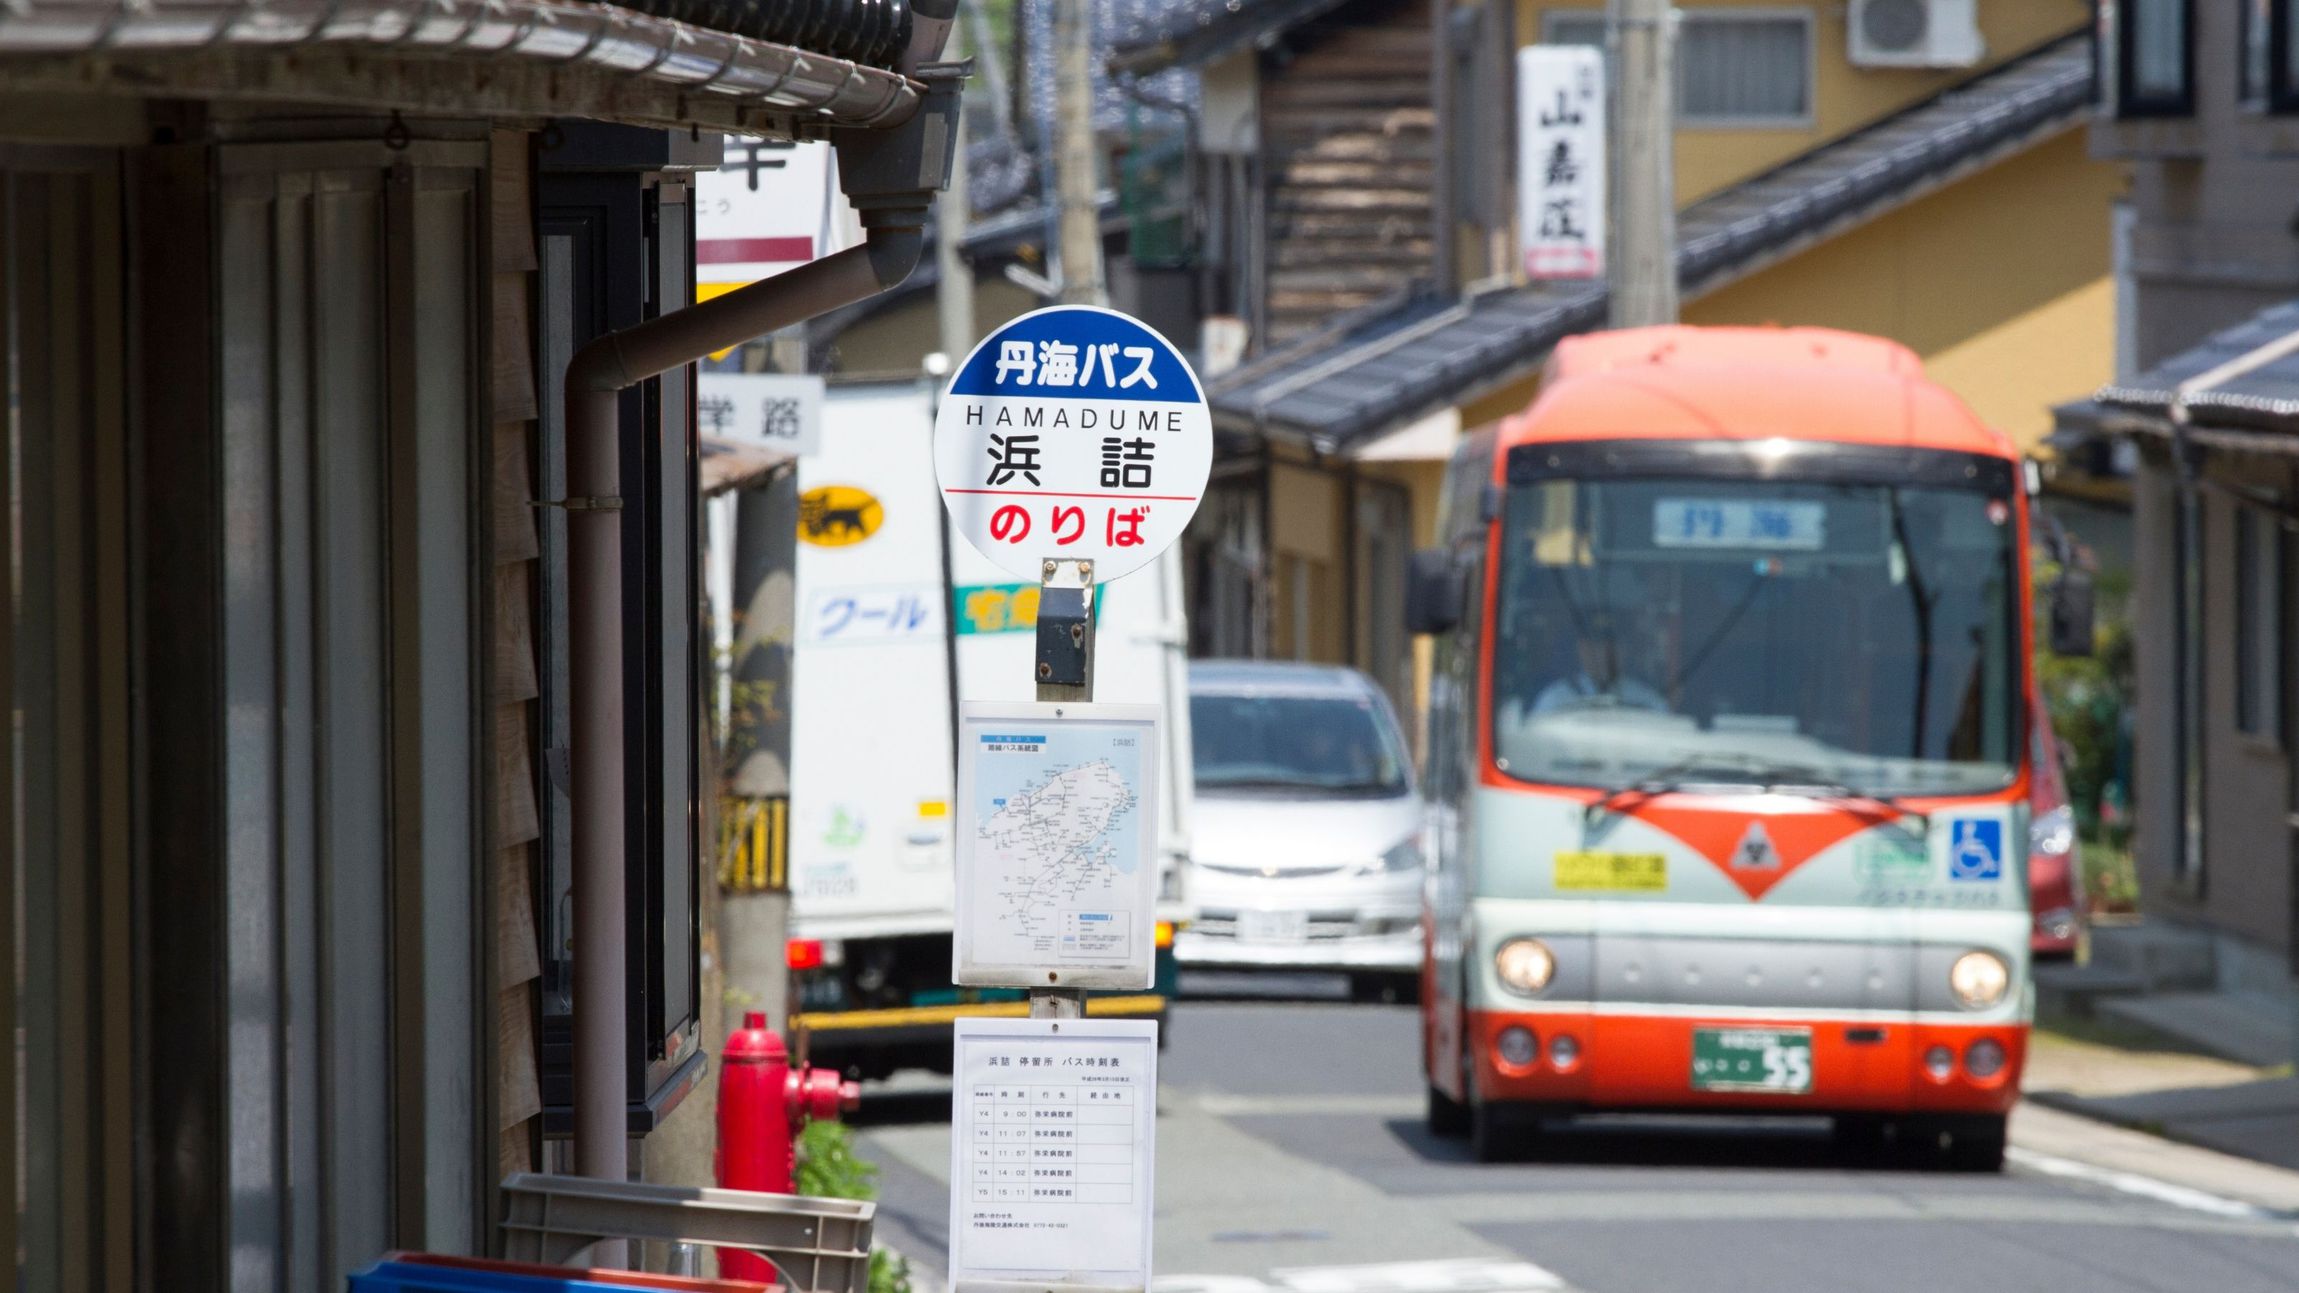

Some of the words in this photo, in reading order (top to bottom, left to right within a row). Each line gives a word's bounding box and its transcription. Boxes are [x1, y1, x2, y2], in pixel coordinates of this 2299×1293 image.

[995, 340, 1158, 390] 丹海バス
[966, 405, 1183, 432] HAMADUME
[990, 504, 1150, 547] のりば
[820, 594, 928, 640] クール
[988, 1056, 1010, 1066] 浜詰
[1019, 1057, 1053, 1067] 停留所
[1062, 1057, 1120, 1067] バス時刻表
[1762, 1046, 1811, 1090] 55
